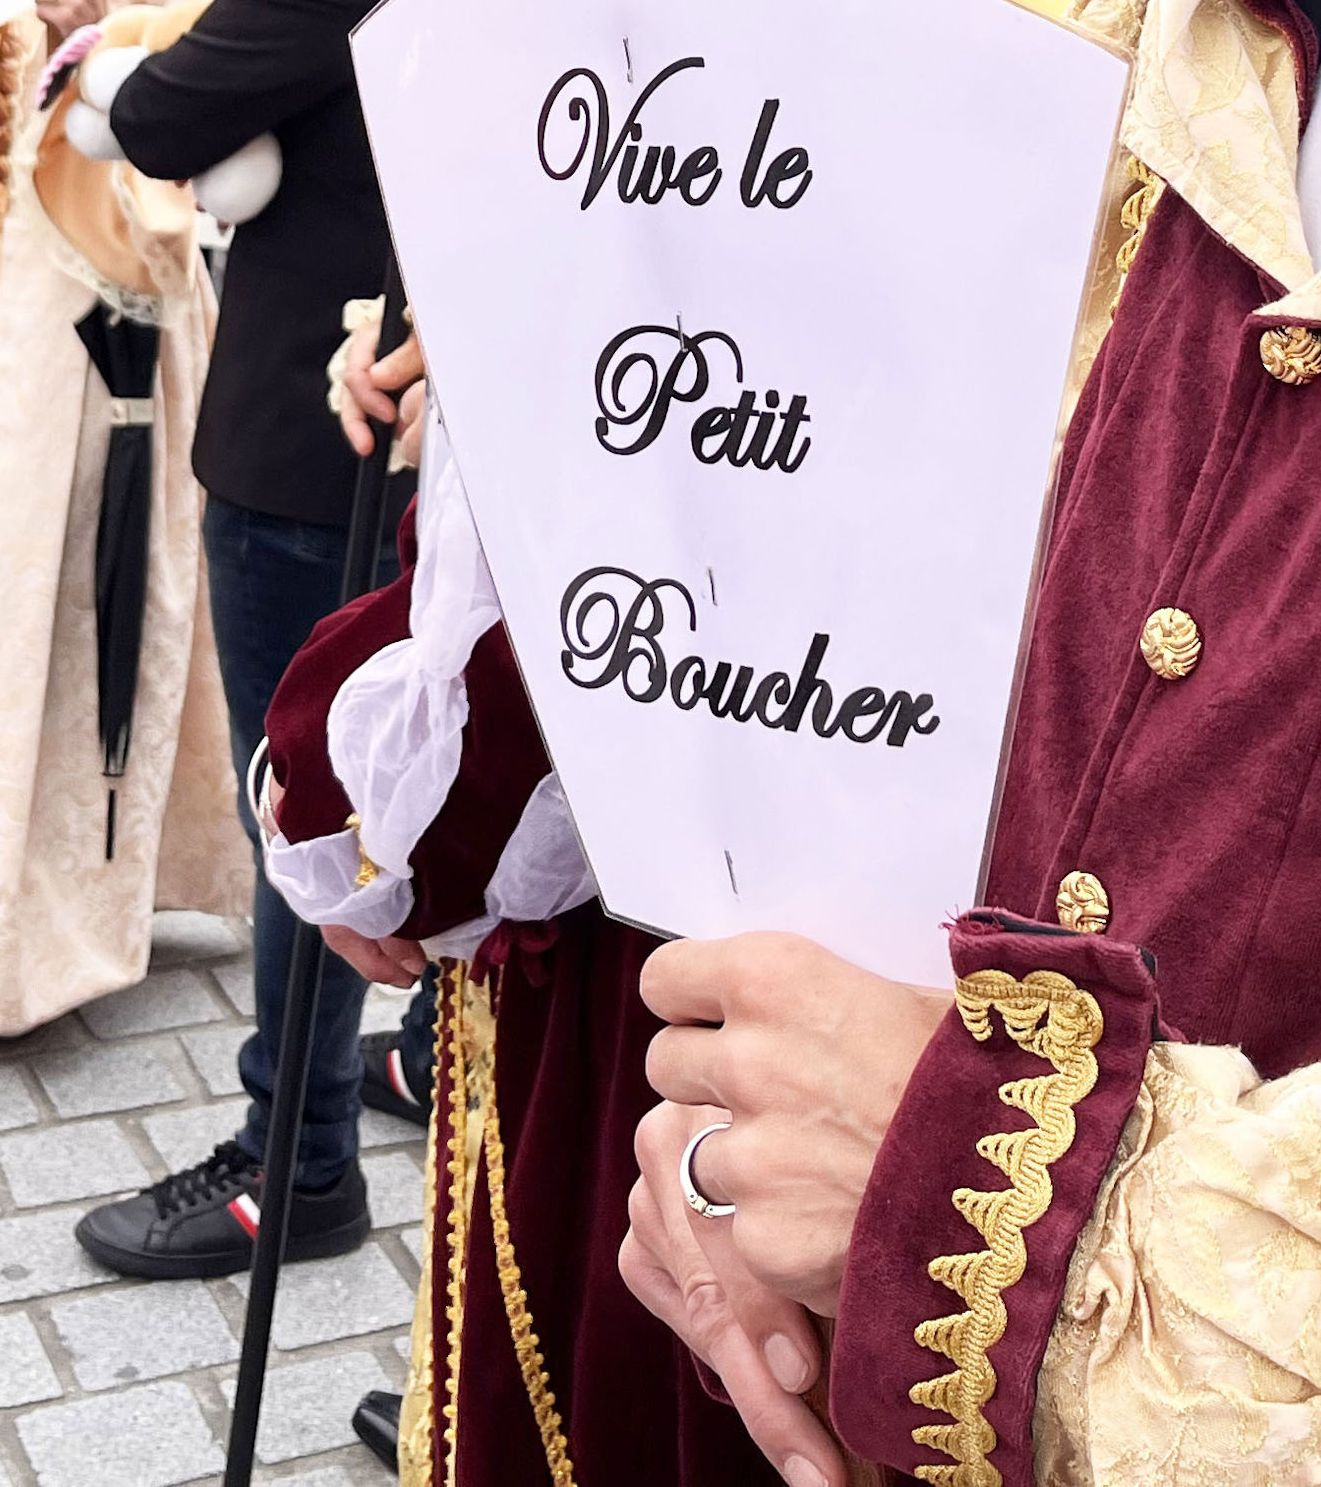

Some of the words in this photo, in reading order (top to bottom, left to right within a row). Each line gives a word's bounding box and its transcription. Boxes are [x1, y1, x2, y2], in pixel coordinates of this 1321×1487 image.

[537, 57, 722, 210] Vive
[739, 98, 813, 209] le
[594, 324, 812, 473] Petit
[559, 565, 941, 748] Boucher
